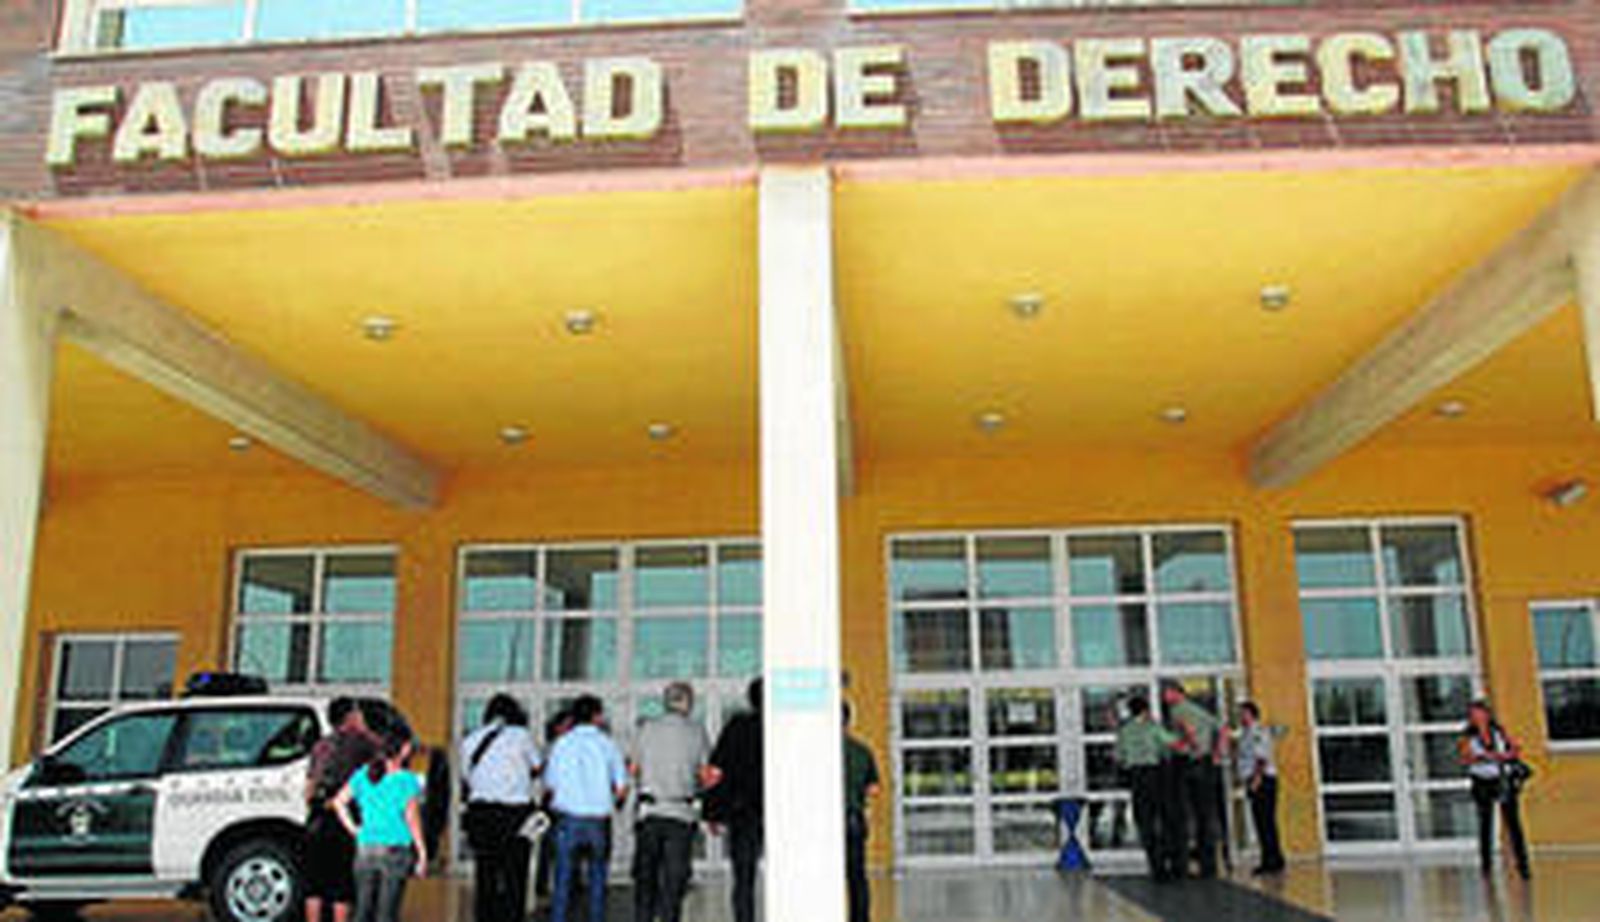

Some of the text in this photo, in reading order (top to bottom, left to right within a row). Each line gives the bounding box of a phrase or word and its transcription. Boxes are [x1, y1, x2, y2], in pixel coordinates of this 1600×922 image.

[46, 29, 1577, 167] FACULTAD DE DERECHO
